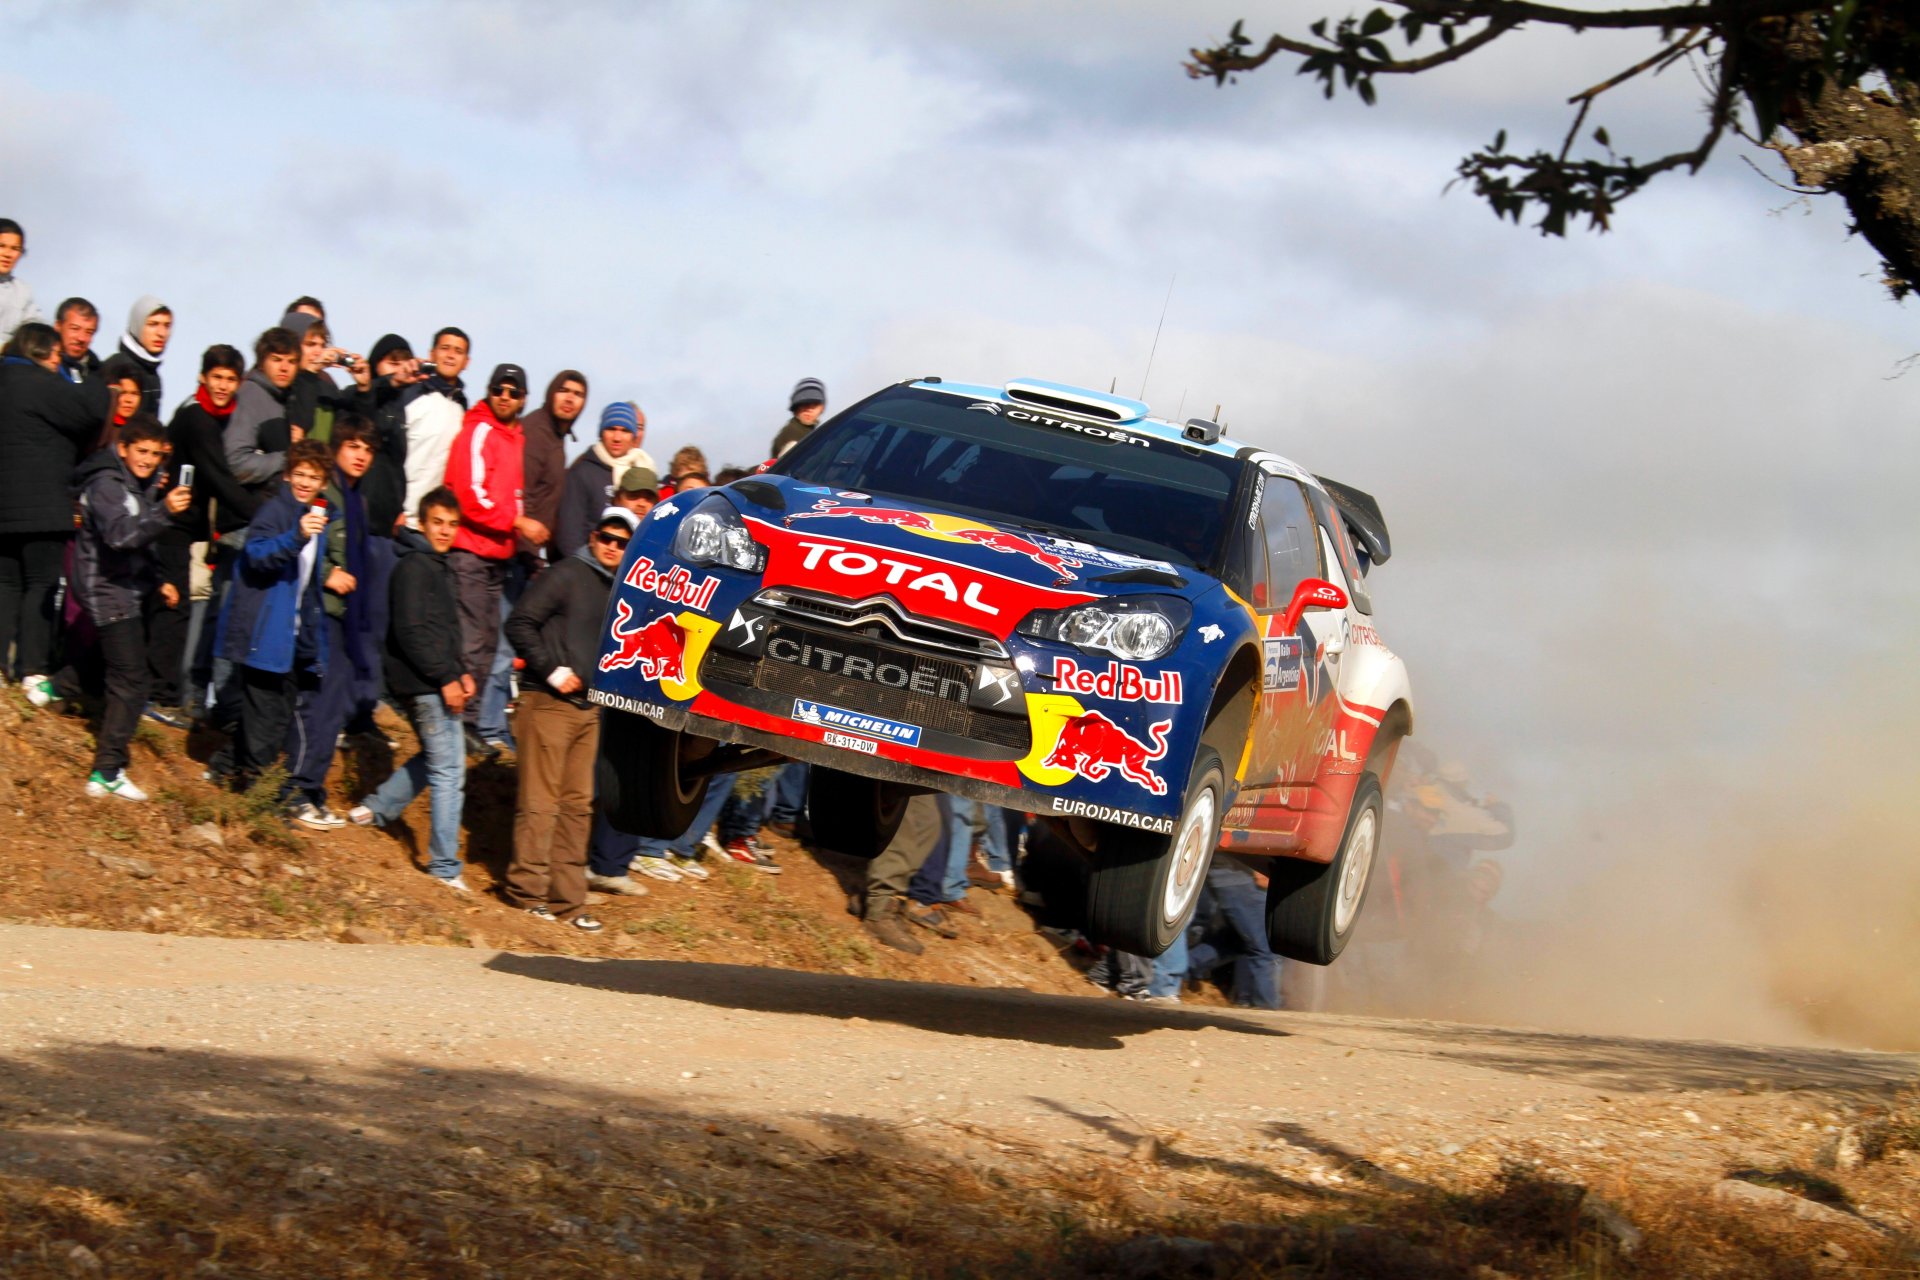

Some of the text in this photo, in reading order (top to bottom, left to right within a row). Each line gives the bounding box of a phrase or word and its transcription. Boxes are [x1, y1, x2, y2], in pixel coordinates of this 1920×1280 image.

[797, 541, 1000, 616] TOTAL
[1312, 593, 1341, 602] OAKLEY
[587, 688, 665, 720] EURODATACAR
[824, 711, 915, 739] MICHELIN
[826, 733, 874, 753] BK-317-DW
[1052, 797, 1174, 834] EURODATACAR
